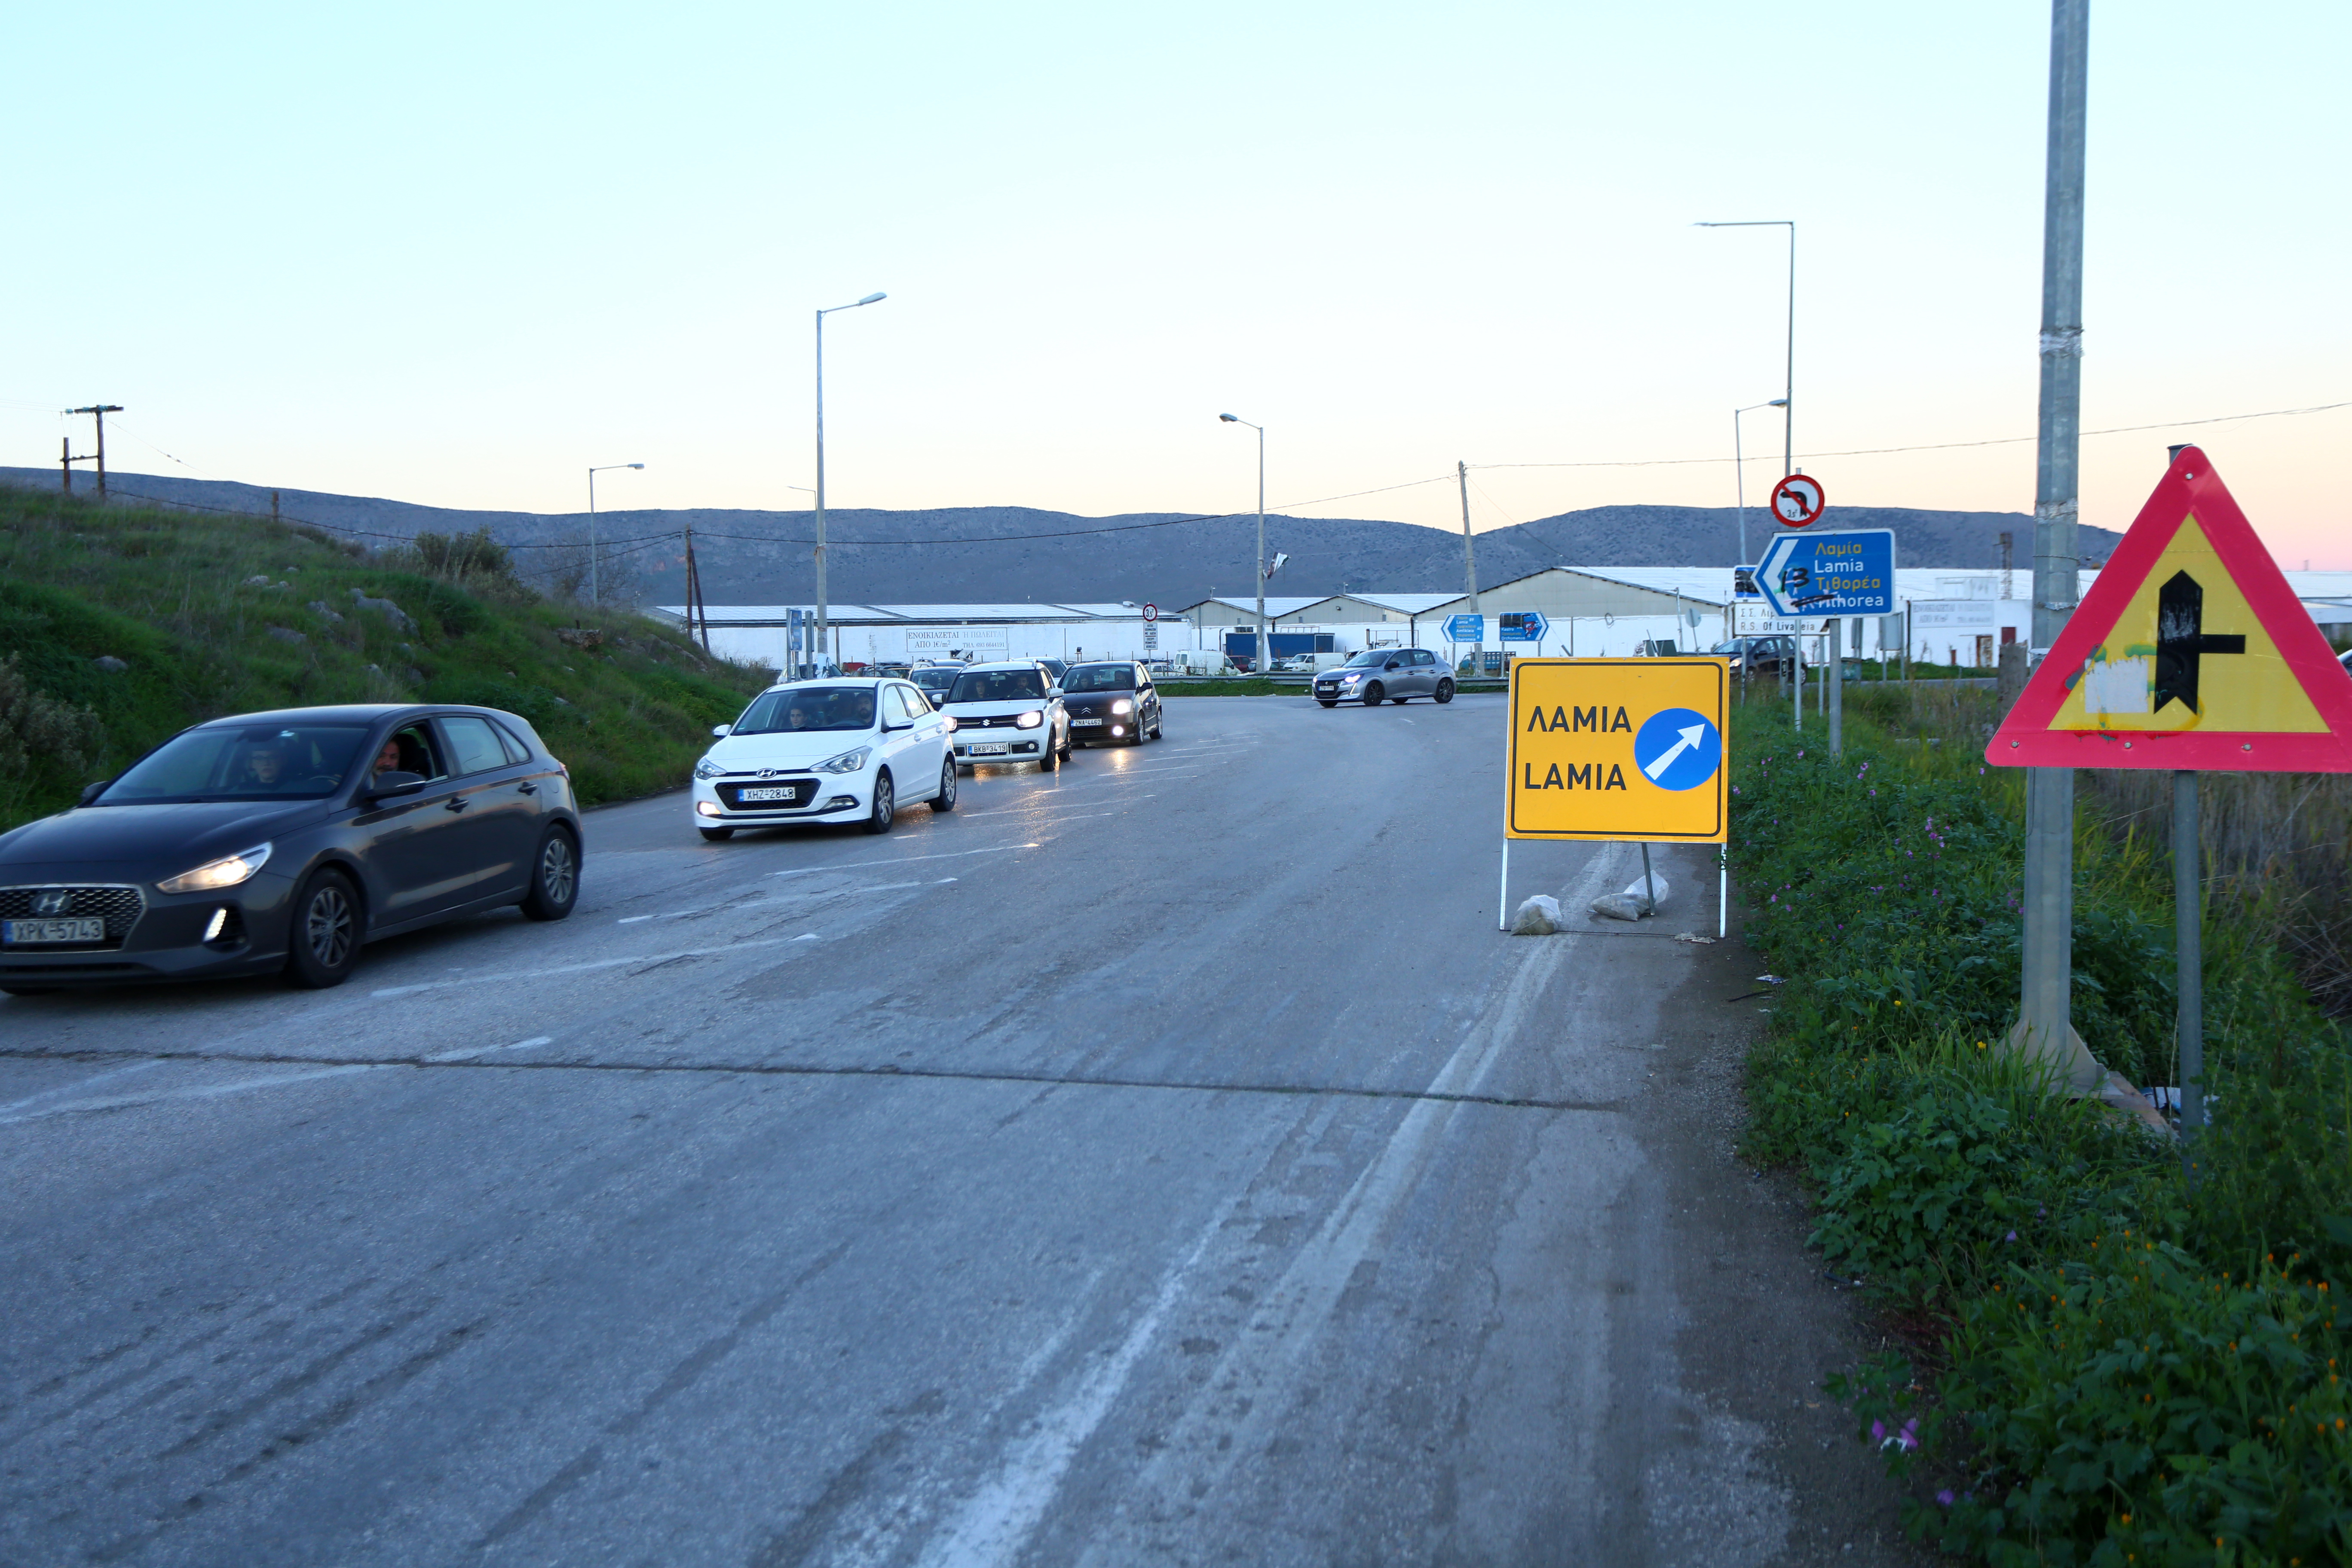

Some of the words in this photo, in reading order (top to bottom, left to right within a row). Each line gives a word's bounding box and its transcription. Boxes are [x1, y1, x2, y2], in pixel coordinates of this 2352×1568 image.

[1815, 541, 1862, 557] Λαμία
[1815, 558, 1864, 573] Lamia
[1815, 576, 1880, 592] Τιθορέα
[1763, 622, 1772, 631] Of
[1777, 622, 1815, 631] Livaeia
[1527, 706, 1632, 732] ΛΑΜΙΑ
[1525, 763, 1627, 790] LAMIA
[747, 788, 793, 799] XHZ-2848
[17, 921, 101, 940] XPK-5743
